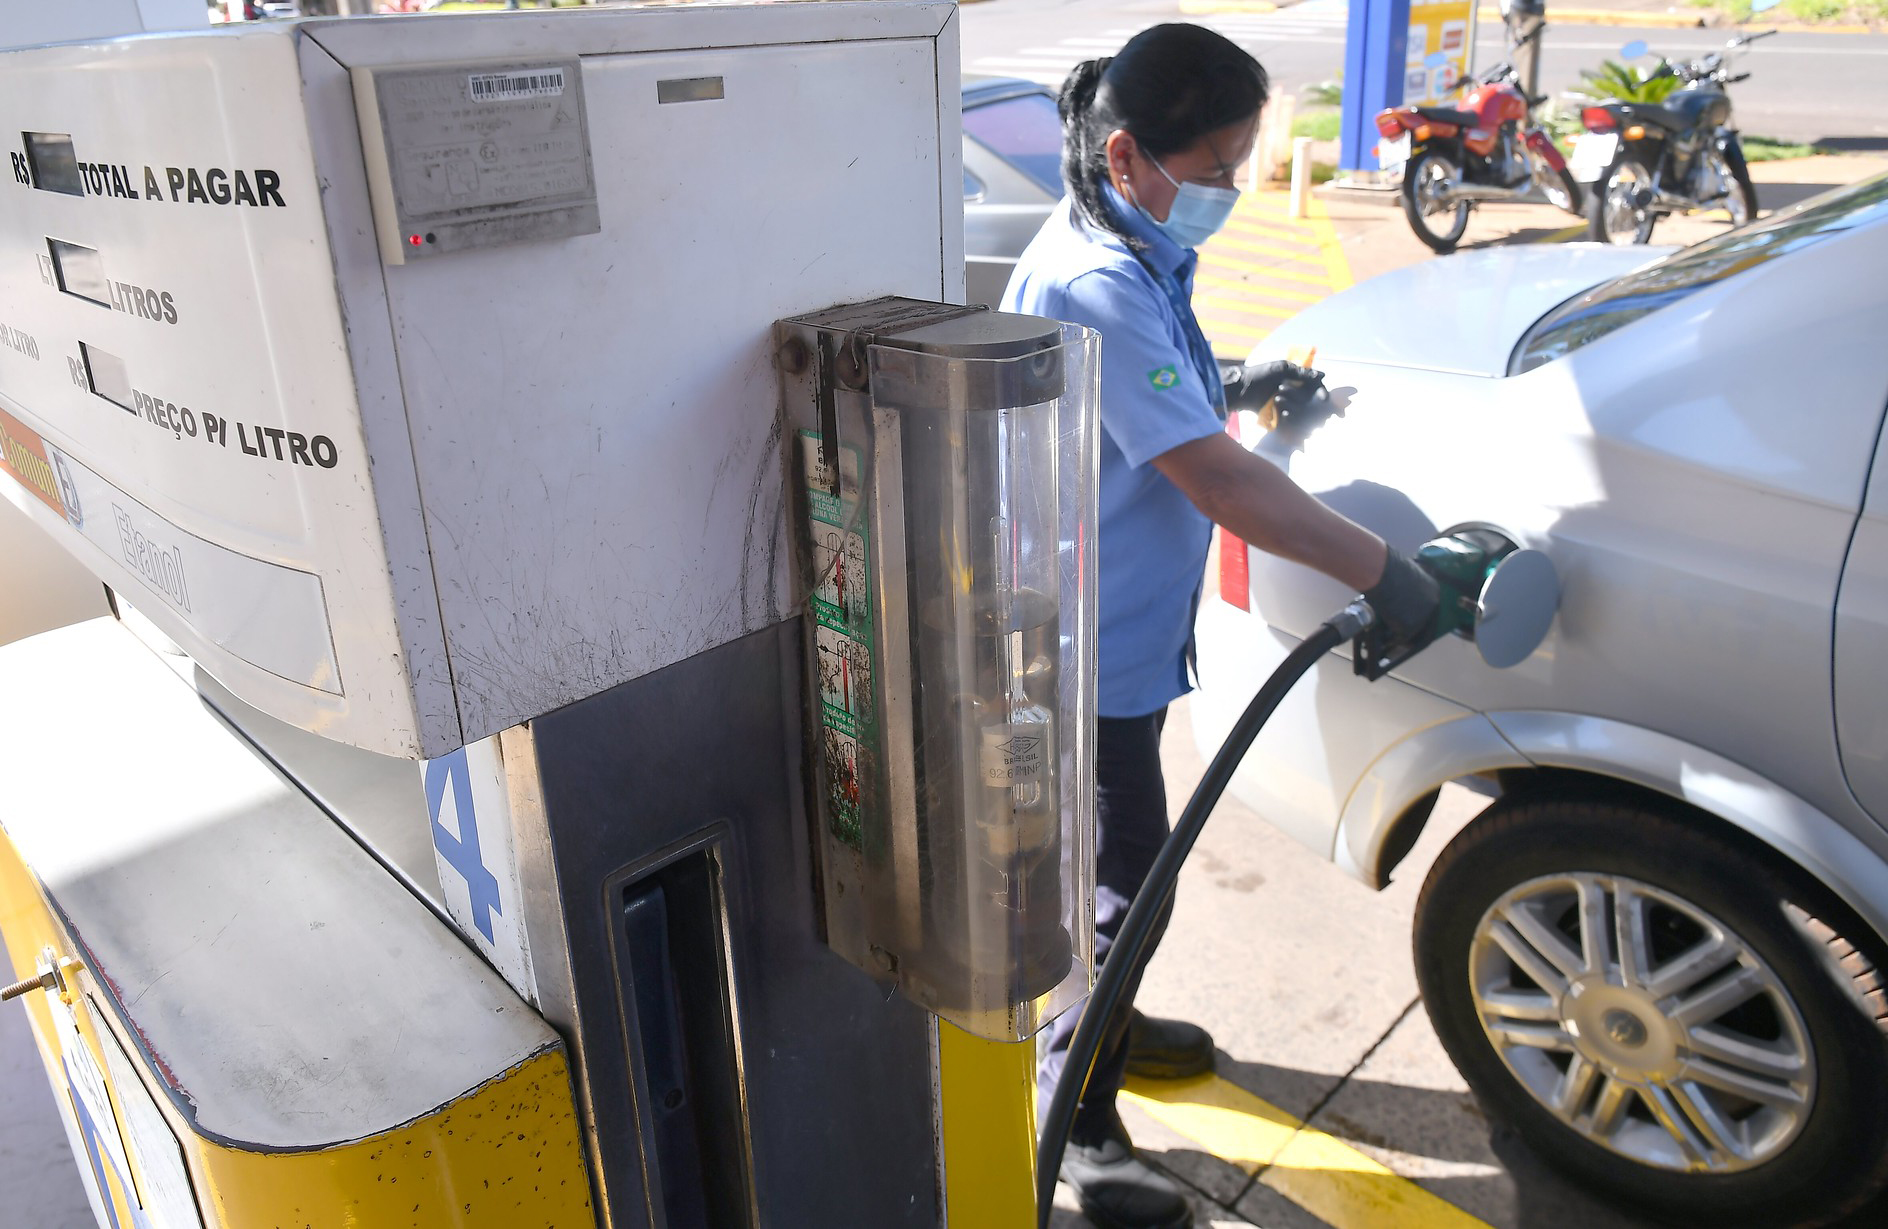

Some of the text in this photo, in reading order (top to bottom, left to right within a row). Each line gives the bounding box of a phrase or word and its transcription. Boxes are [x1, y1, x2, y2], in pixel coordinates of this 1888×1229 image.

[10, 151, 287, 208] R$ TOTAL A PAGAR
[105, 278, 178, 326] LITROS
[9, 326, 40, 361] LITRO
[132, 388, 198, 441] PREÇO
[236, 421, 339, 470] LITRO
[112, 502, 192, 614] Etanol
[424, 746, 502, 948] 4
